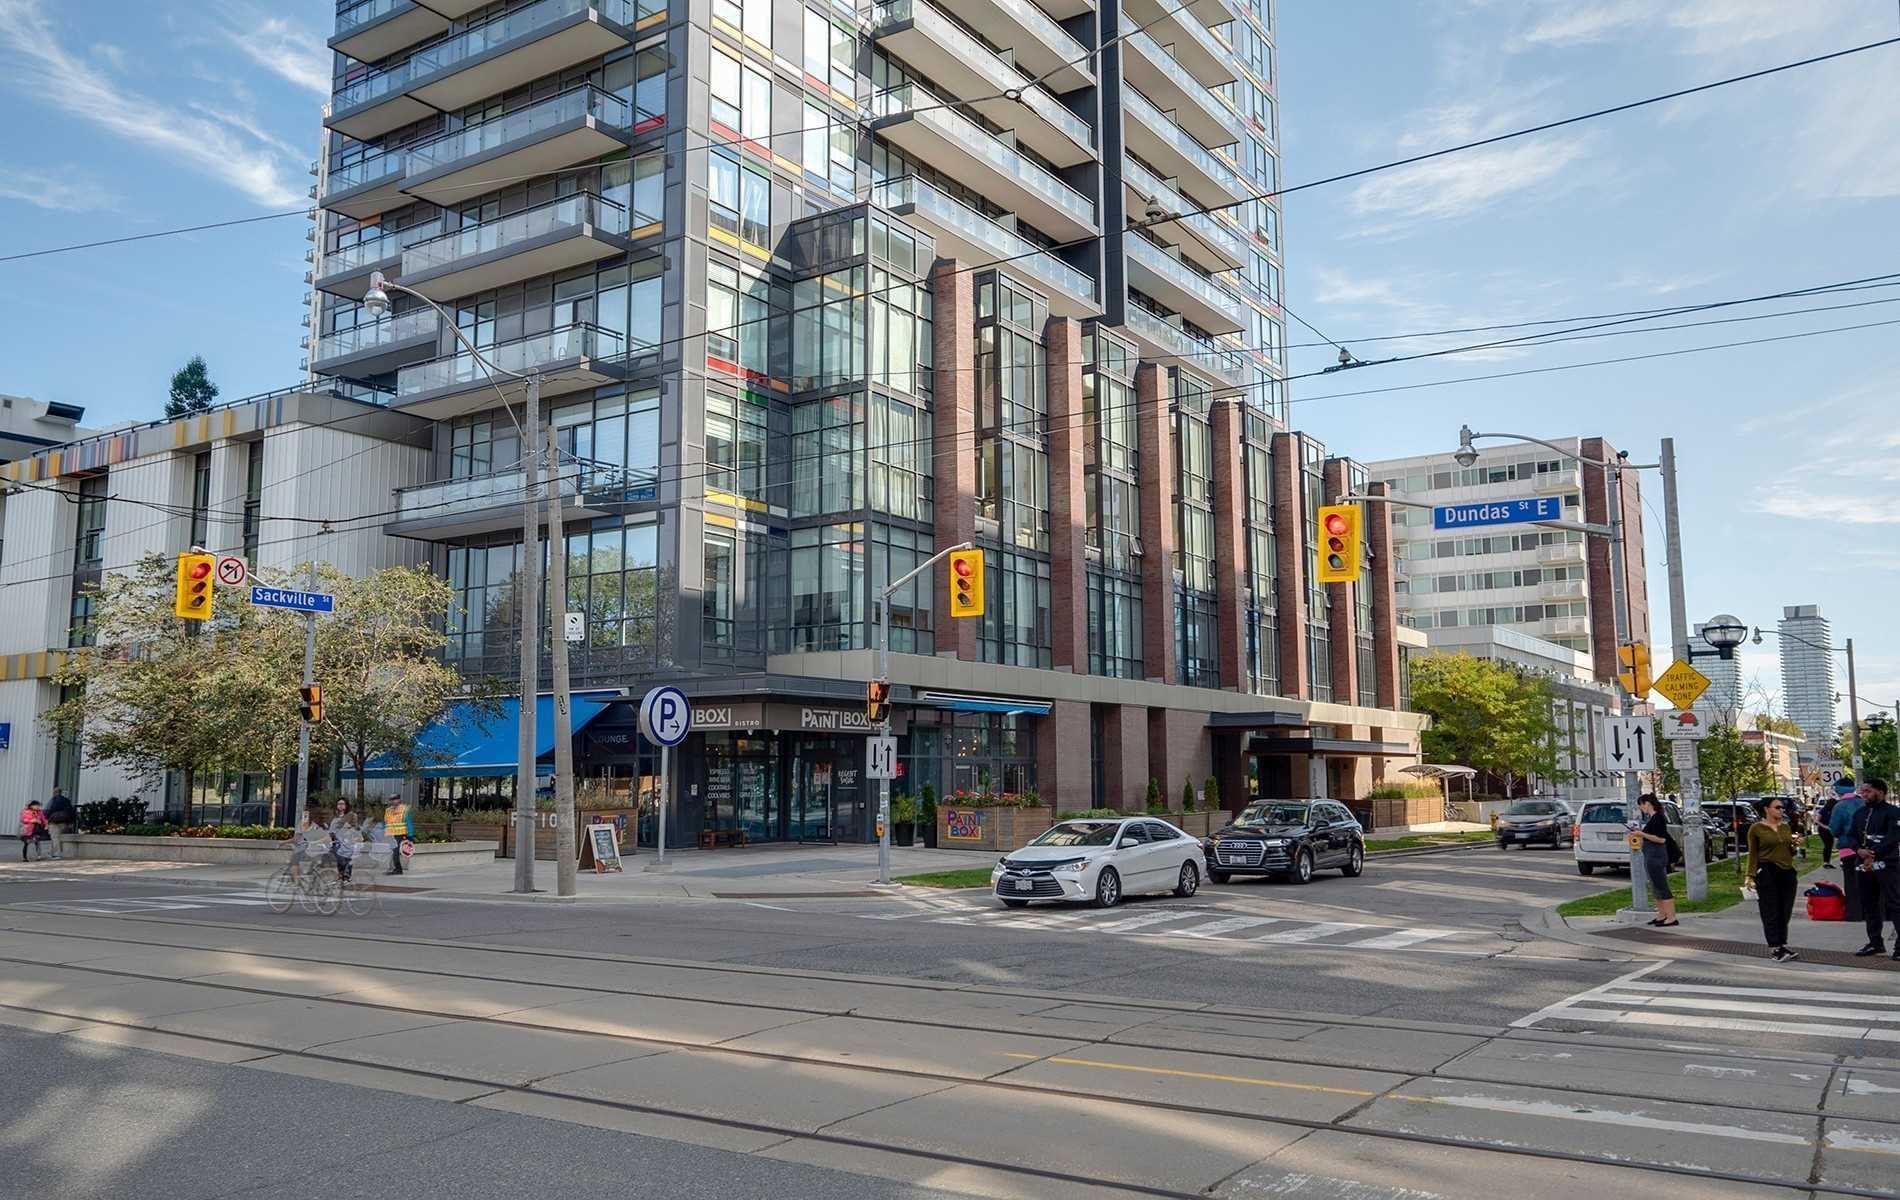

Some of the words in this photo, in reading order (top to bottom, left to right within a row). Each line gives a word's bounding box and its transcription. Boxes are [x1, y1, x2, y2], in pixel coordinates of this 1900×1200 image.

[1445, 504, 1510, 523] Dundas
[1519, 501, 1529, 510] St
[1536, 499, 1548, 515] E
[255, 588, 316, 606] Sackville
[1665, 672, 1697, 681] TRAFFIC
[1664, 682, 1699, 692] CALMING
[1672, 692, 1693, 701] ZONE
[660, 698, 677, 733] P
[695, 708, 728, 723] BOX
[734, 719, 760, 727] BISTRO
[843, 711, 869, 726] BOX
[1823, 770, 1842, 782] 30
[951, 826, 979, 837] BOX
